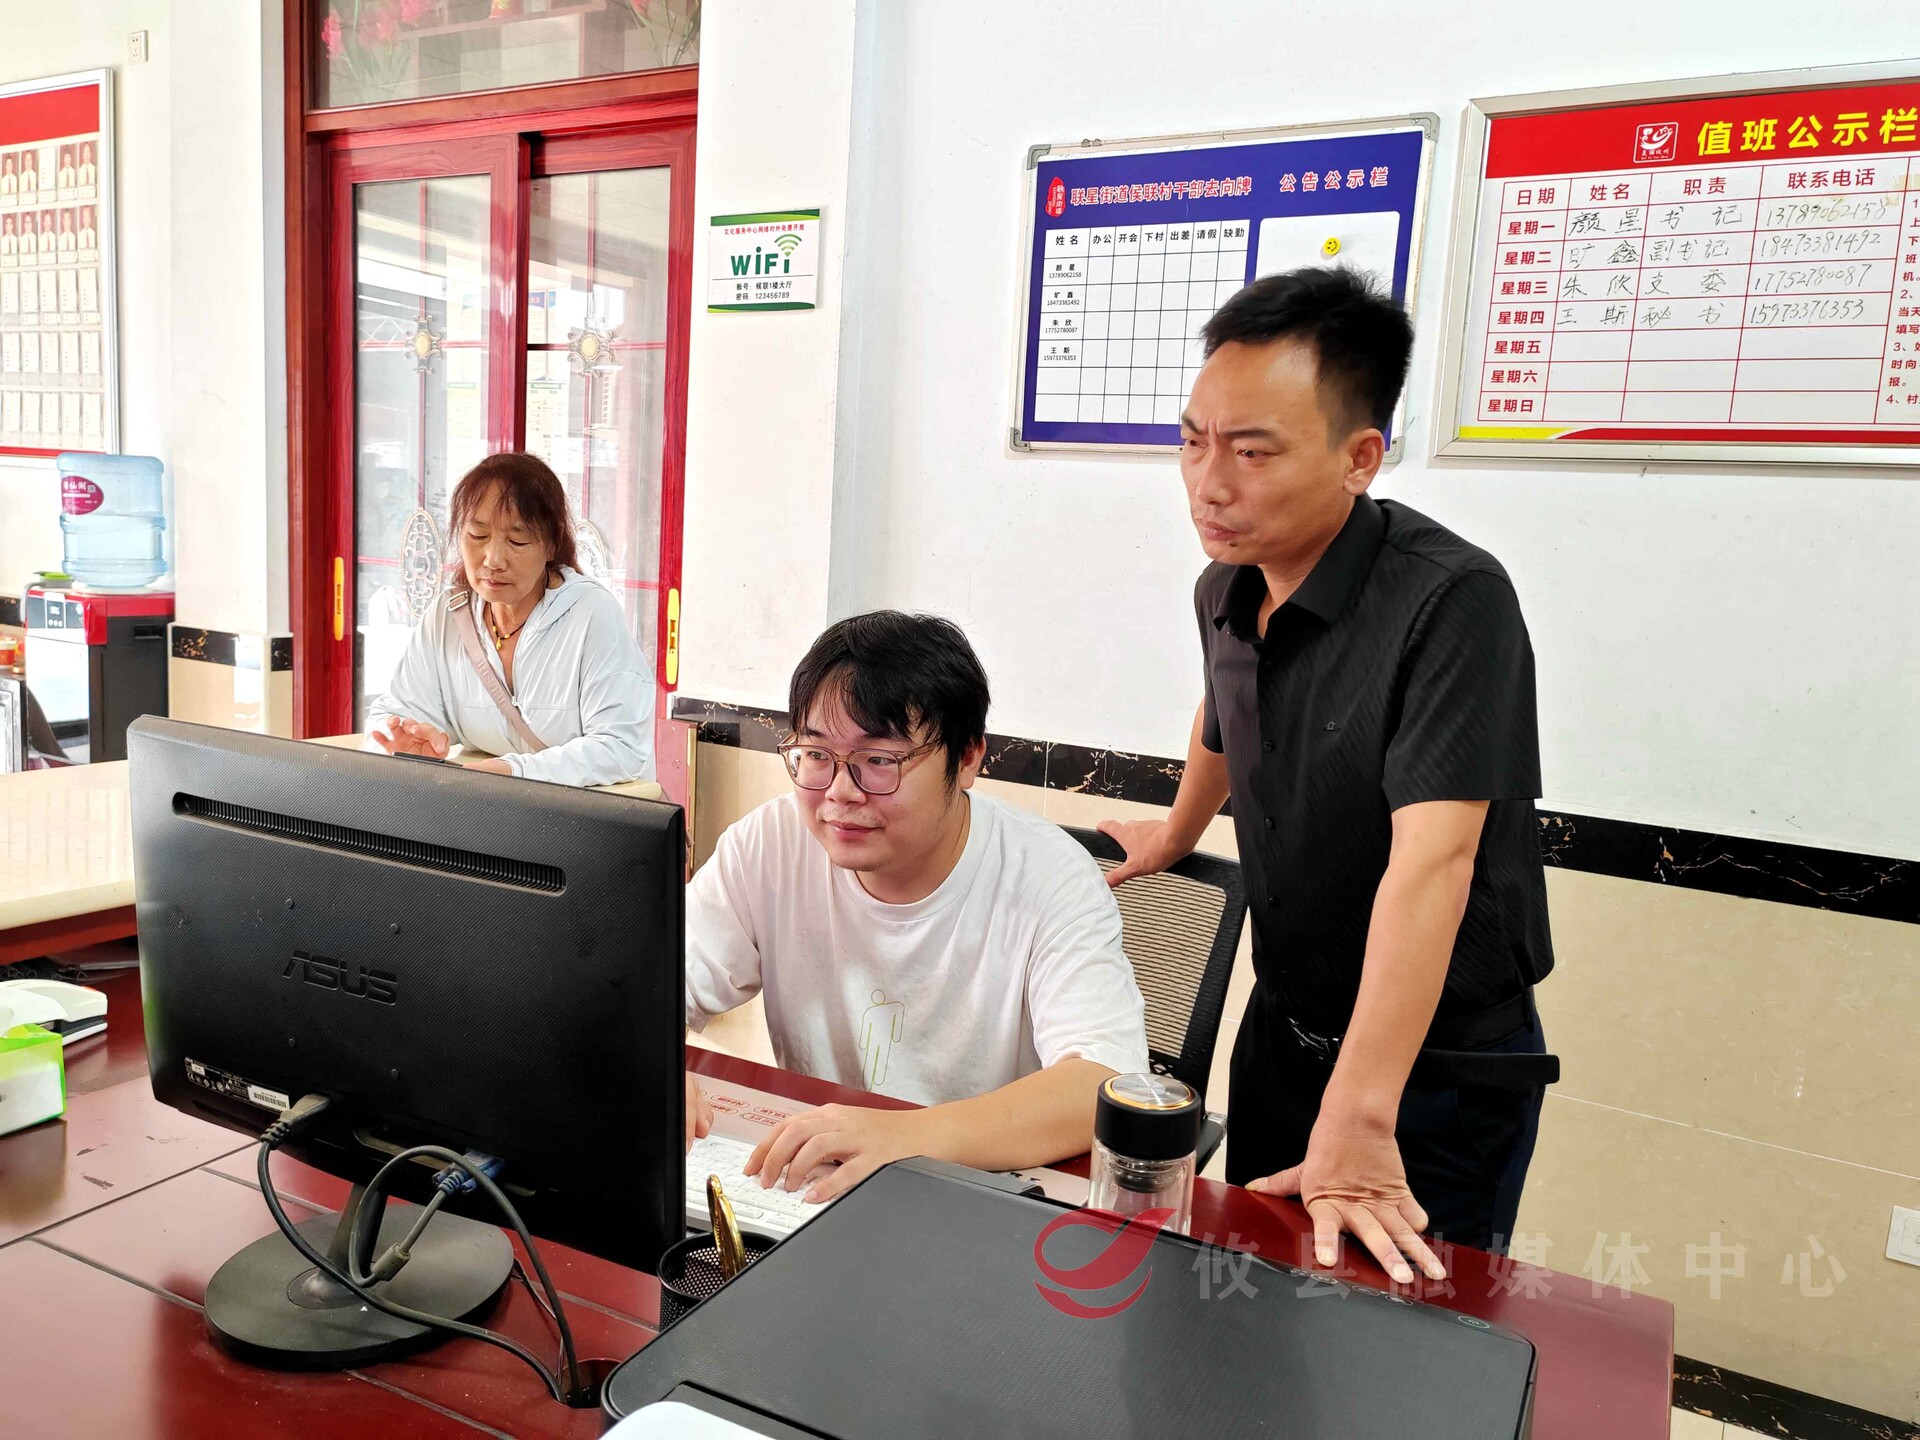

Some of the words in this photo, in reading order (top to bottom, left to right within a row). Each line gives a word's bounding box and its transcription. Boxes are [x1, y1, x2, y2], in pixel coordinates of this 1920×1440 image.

[1697, 107, 1919, 157] 值班公示栏
[1279, 166, 1390, 193] 公告公示栏
[1682, 176, 1727, 196] 职责
[1787, 168, 1876, 190] 联系电话
[1070, 177, 1252, 206] 联星街道侯联村干部去向牌
[1517, 187, 1556, 206] 日期
[1589, 183, 1630, 202] 姓名
[1766, 198, 1887, 227] 13789062158
[1170, 230, 1191, 241] 出差
[1196, 229, 1217, 239] 请假
[1223, 227, 1245, 238] 缺勤
[1507, 220, 1556, 236] 星期一
[1055, 235, 1079, 246] 姓名
[1092, 234, 1112, 244] 办公
[1118, 233, 1138, 243] 开会
[1145, 232, 1164, 242] 下村
[1761, 229, 1881, 258] 18473381492
[1908, 236, 1919, 247] 下
[1504, 251, 1551, 266] 星期二
[1904, 253, 1918, 265] 班
[1754, 263, 1873, 293] 17752780087
[1500, 281, 1548, 295] 星期三
[1497, 310, 1545, 325] 星期四
[1750, 298, 1865, 326] 15973376353
[1897, 306, 1920, 318] 当天
[1895, 324, 1920, 336] 填写
[1493, 340, 1542, 355] 星期五
[1490, 369, 1538, 384] 星期六
[1487, 399, 1534, 413] 星期日
[282, 950, 398, 1006] ASUS
